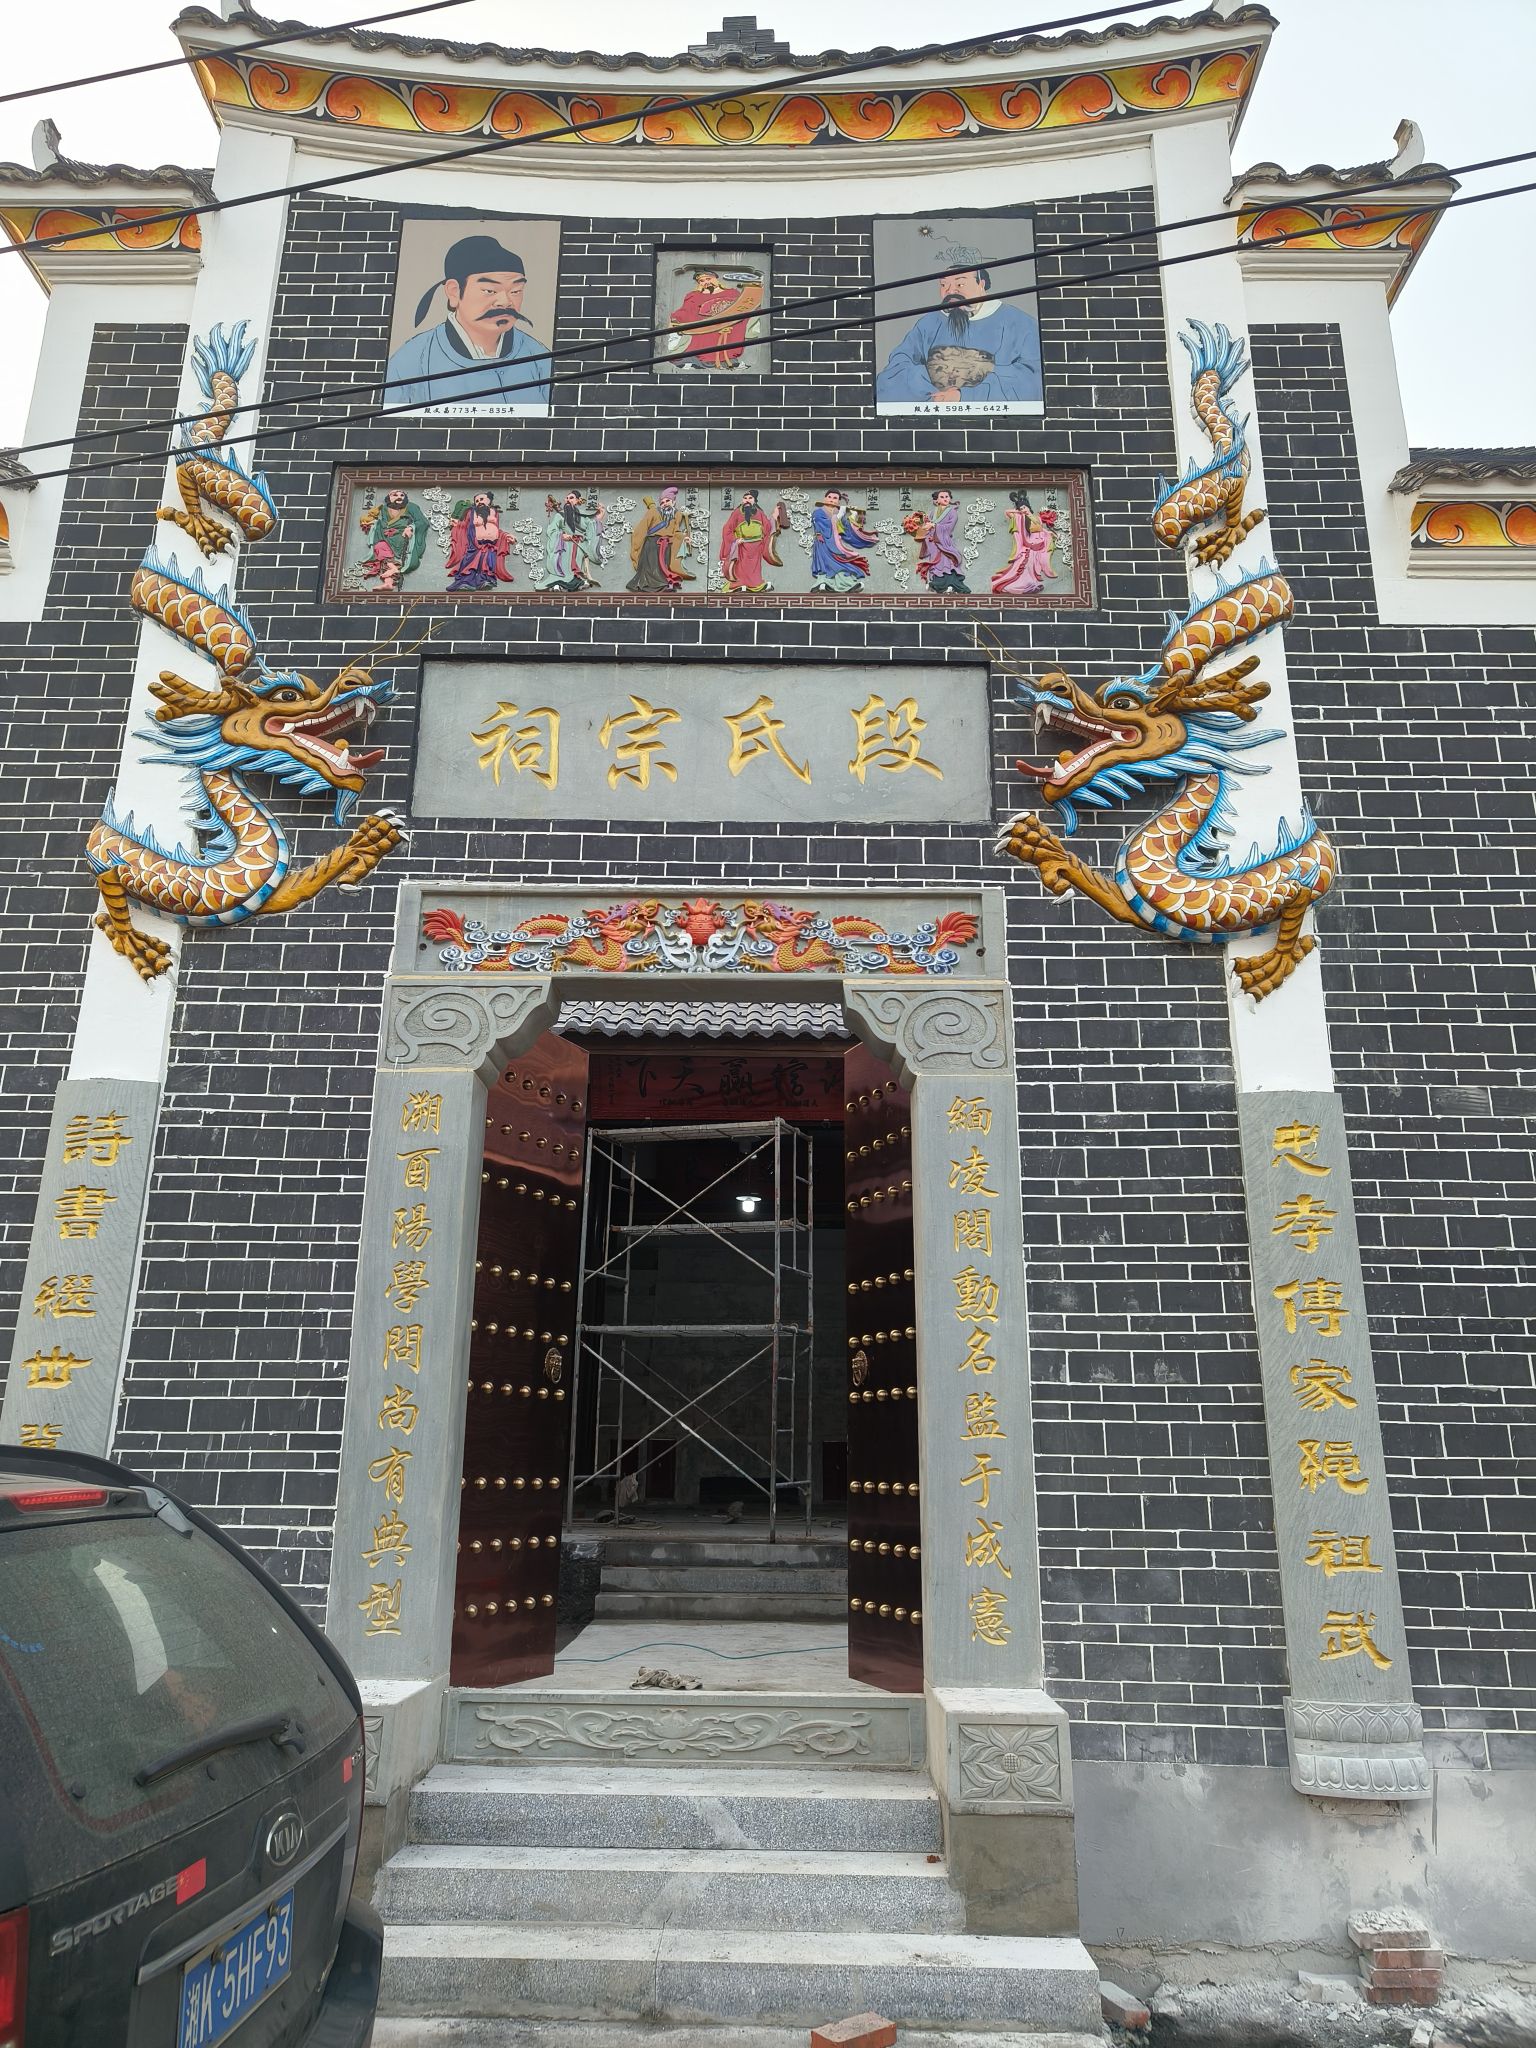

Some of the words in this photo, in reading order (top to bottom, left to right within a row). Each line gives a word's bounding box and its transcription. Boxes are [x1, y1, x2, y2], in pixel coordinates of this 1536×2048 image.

[470, 693, 944, 792] 段氏宗祠
[51, 1874, 178, 1957] SPORTAGE
